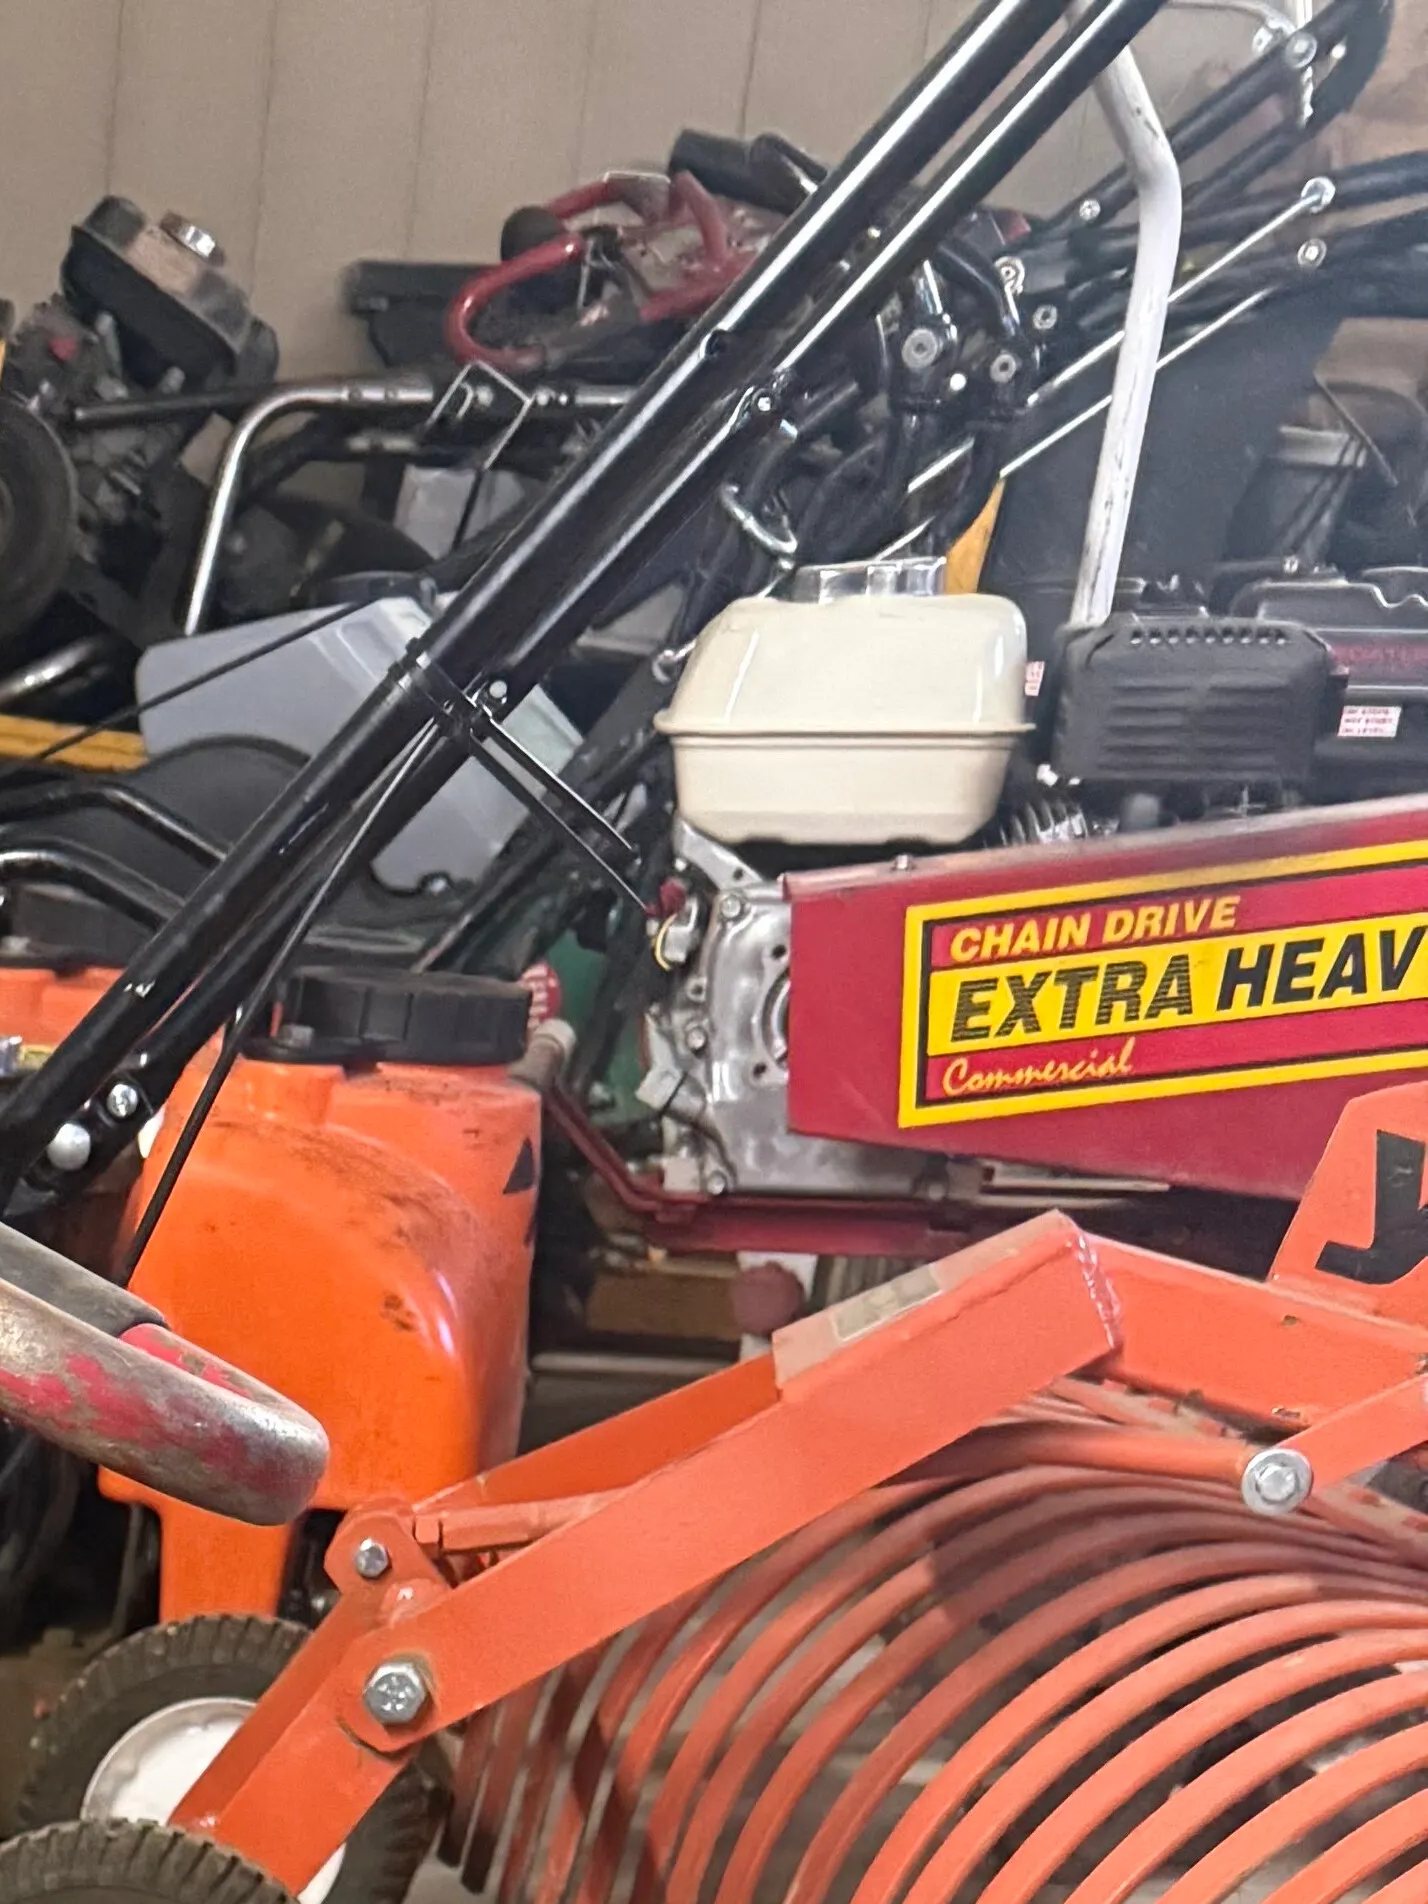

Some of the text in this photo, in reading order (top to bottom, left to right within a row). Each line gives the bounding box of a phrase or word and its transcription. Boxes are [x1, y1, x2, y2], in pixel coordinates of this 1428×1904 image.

[951, 895, 1240, 963] CHAIN DRIVE
[951, 954, 1194, 1042] EXTRA
[943, 1037, 1136, 1096] Commercial
